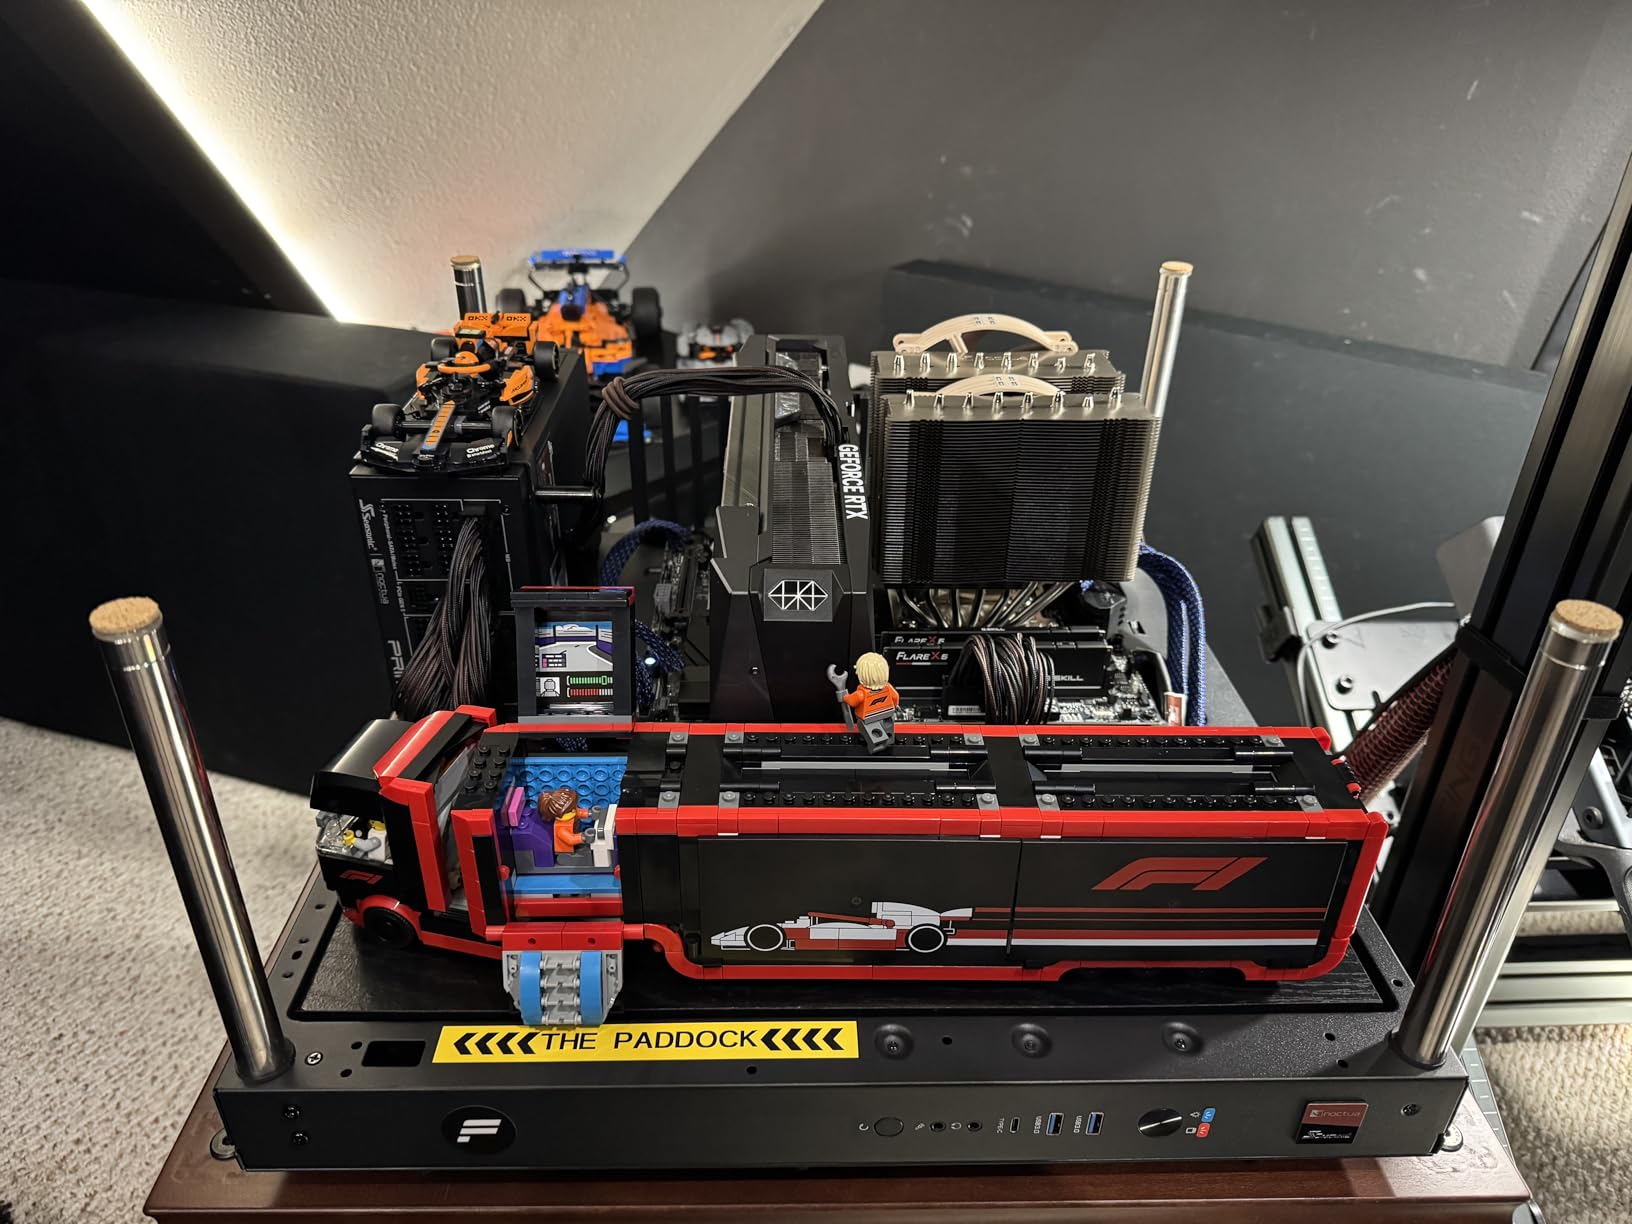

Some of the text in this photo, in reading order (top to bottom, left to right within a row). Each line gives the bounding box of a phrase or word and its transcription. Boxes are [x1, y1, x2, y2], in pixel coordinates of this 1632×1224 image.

[838, 444, 868, 520] GEFORCE RTX
[387, 640, 405, 684] PRI
[896, 651, 931, 660] FLARE
[541, 1030, 759, 1050] THE PADDOCK
